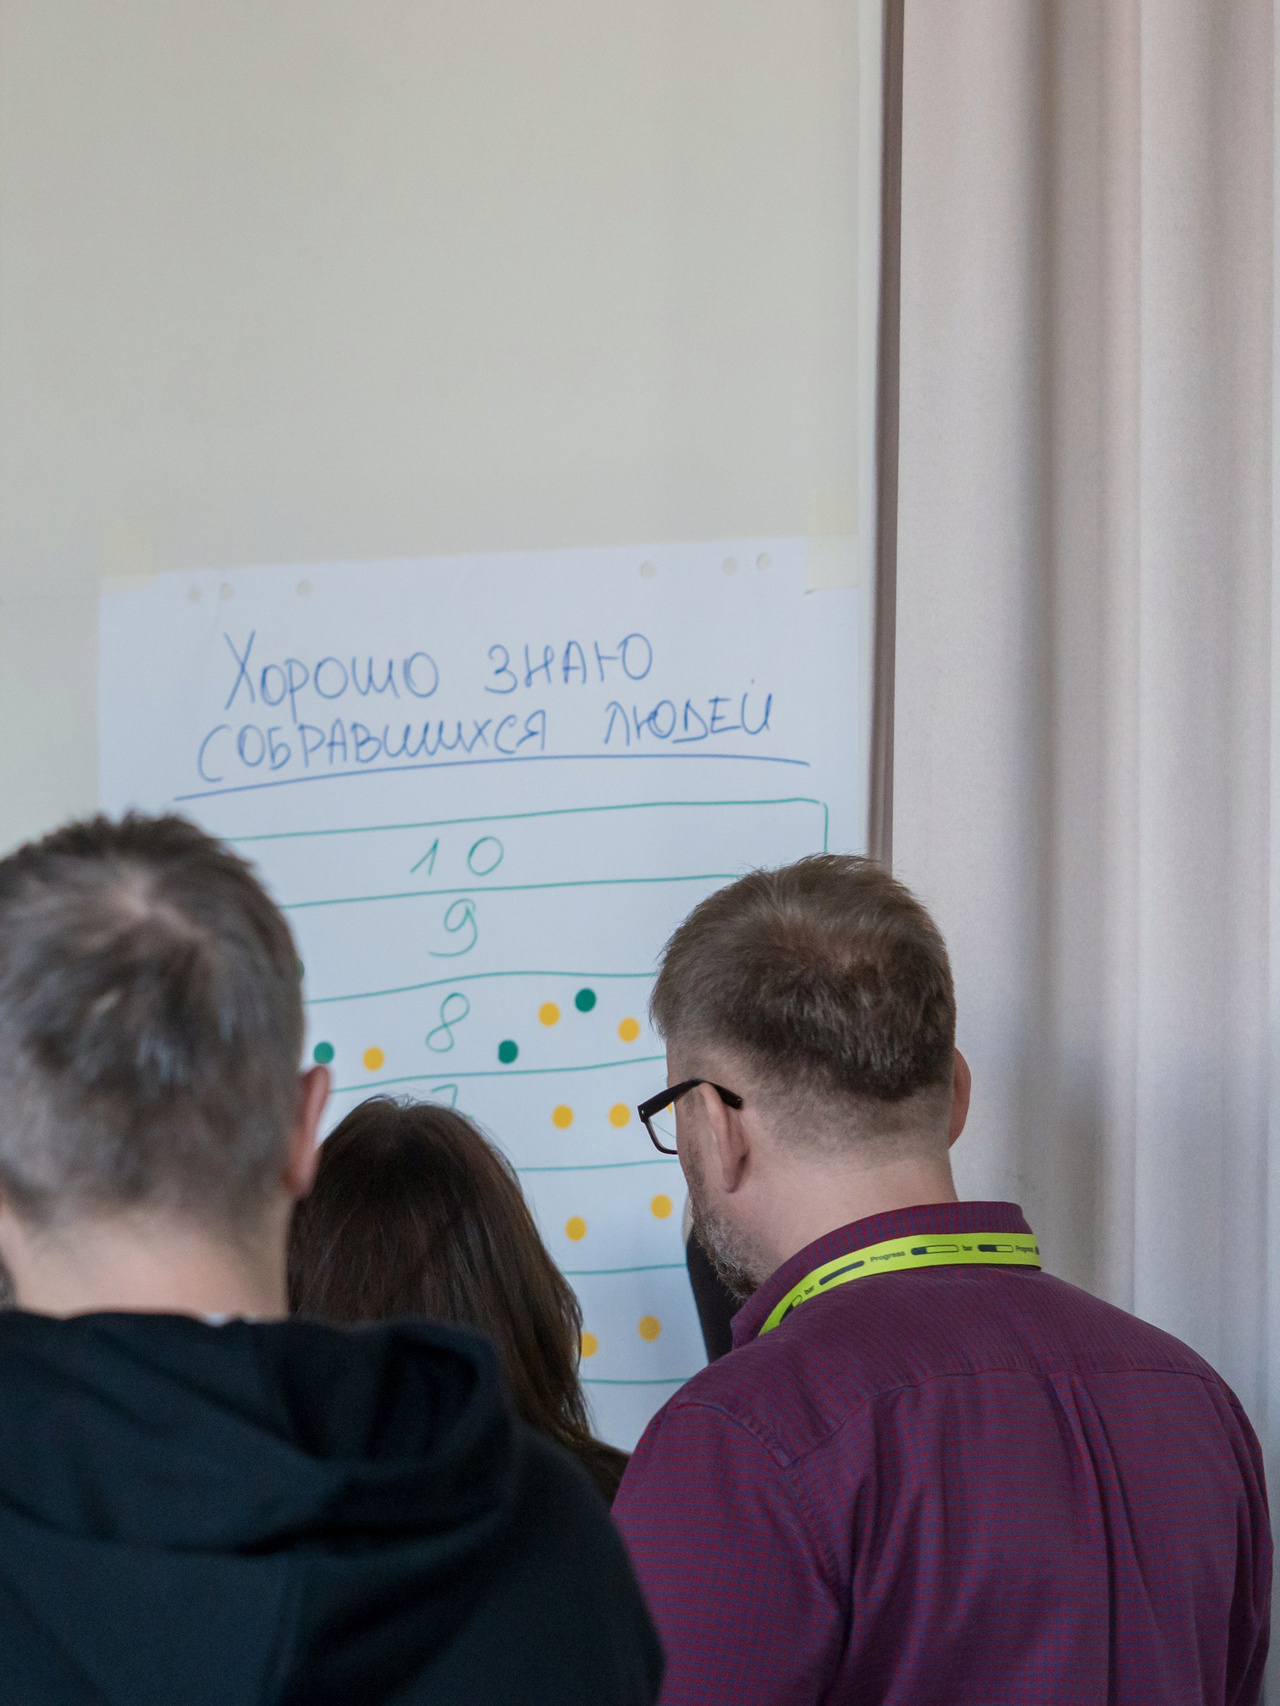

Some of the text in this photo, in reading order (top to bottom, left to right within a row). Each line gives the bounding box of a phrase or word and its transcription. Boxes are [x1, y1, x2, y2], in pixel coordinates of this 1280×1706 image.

[485, 633, 653, 694] ЗНАЮ
[197, 678, 773, 783] СОБРАВШИХСЯ ЛЮДЕЙ
[410, 836, 505, 877] 10
[428, 897, 478, 957] 9
[425, 991, 471, 1053] 8
[870, 1251, 906, 1263] Progress
